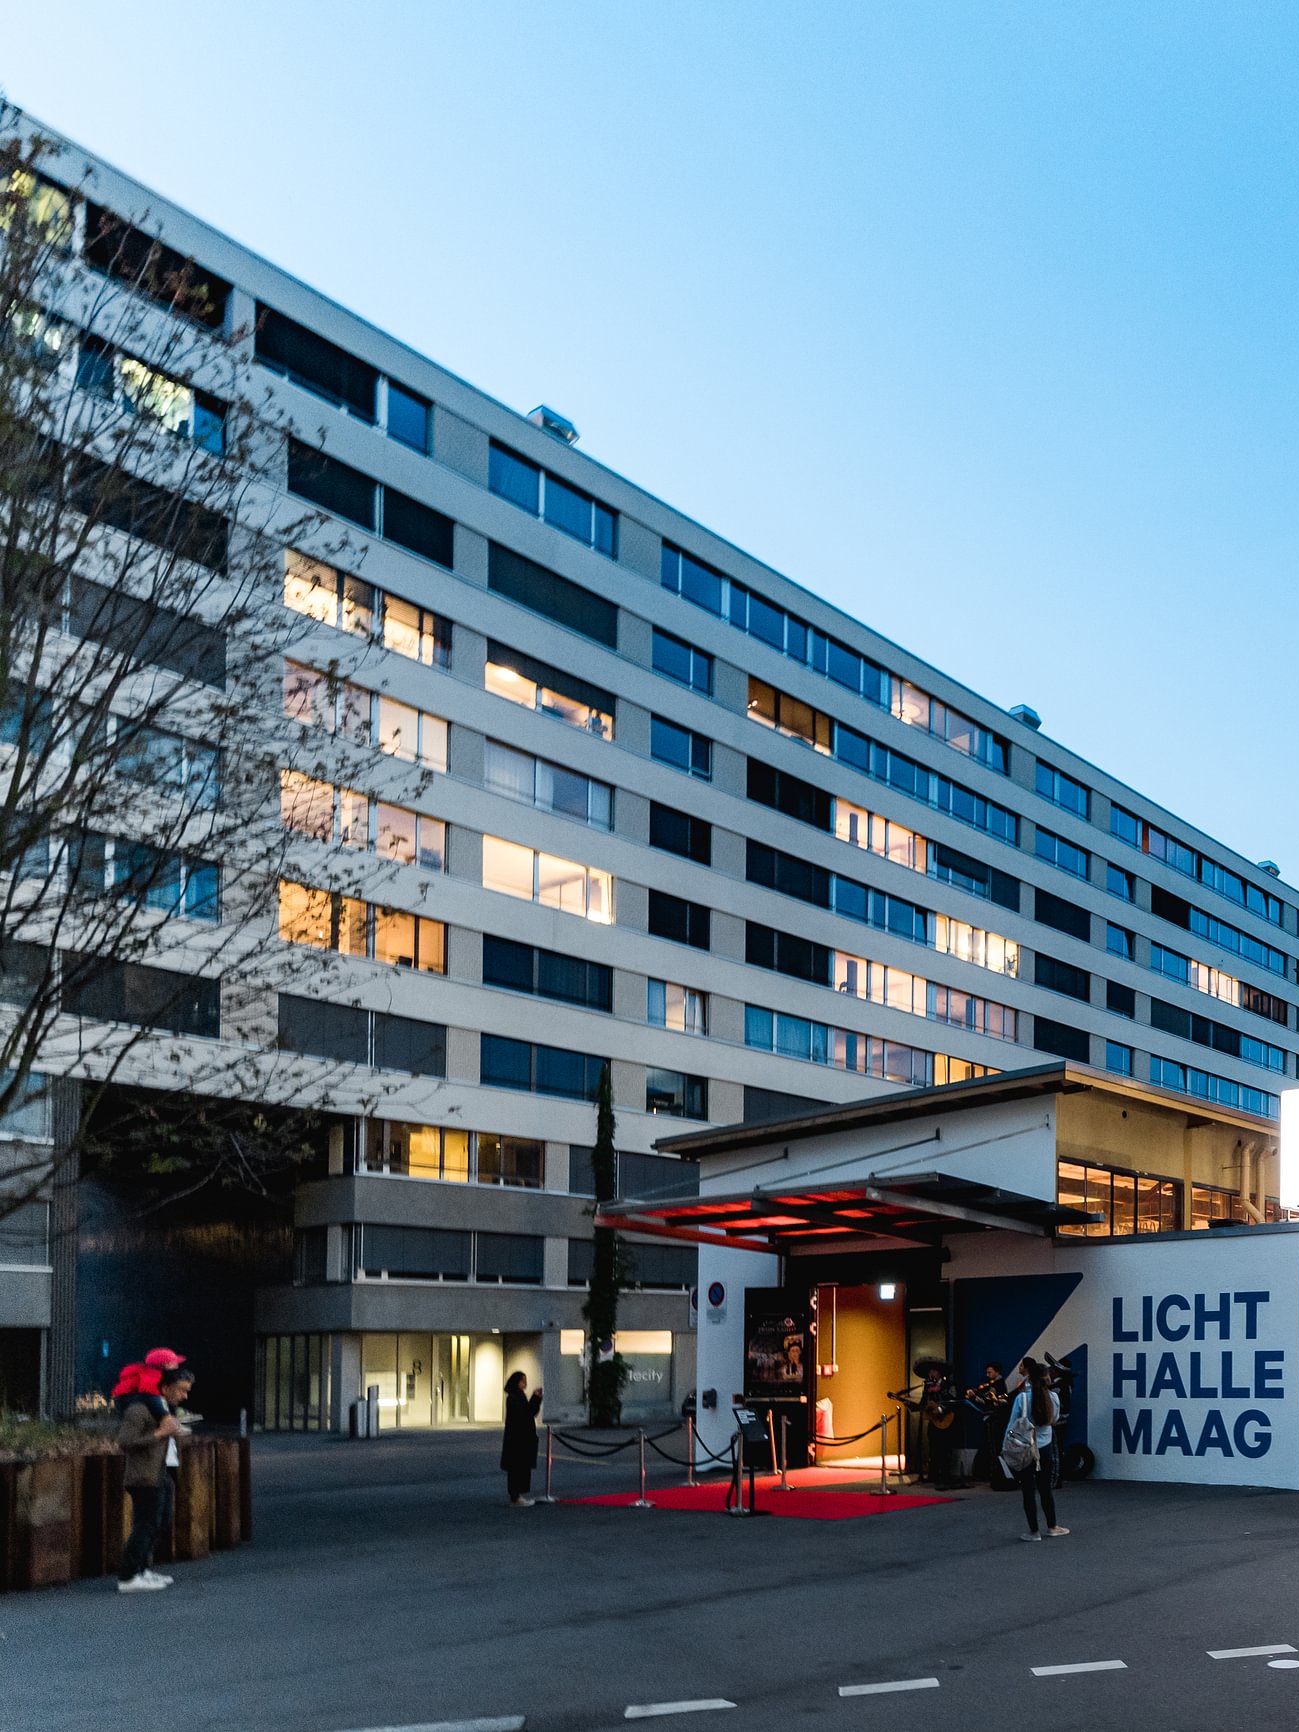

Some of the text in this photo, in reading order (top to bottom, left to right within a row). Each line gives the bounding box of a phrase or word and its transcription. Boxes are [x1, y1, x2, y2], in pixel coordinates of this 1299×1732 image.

[1113, 1291, 1269, 1342] LICHT
[629, 1369, 663, 1384] locity
[1112, 1351, 1284, 1398] HALLE
[1112, 1409, 1271, 1458] MAAG
